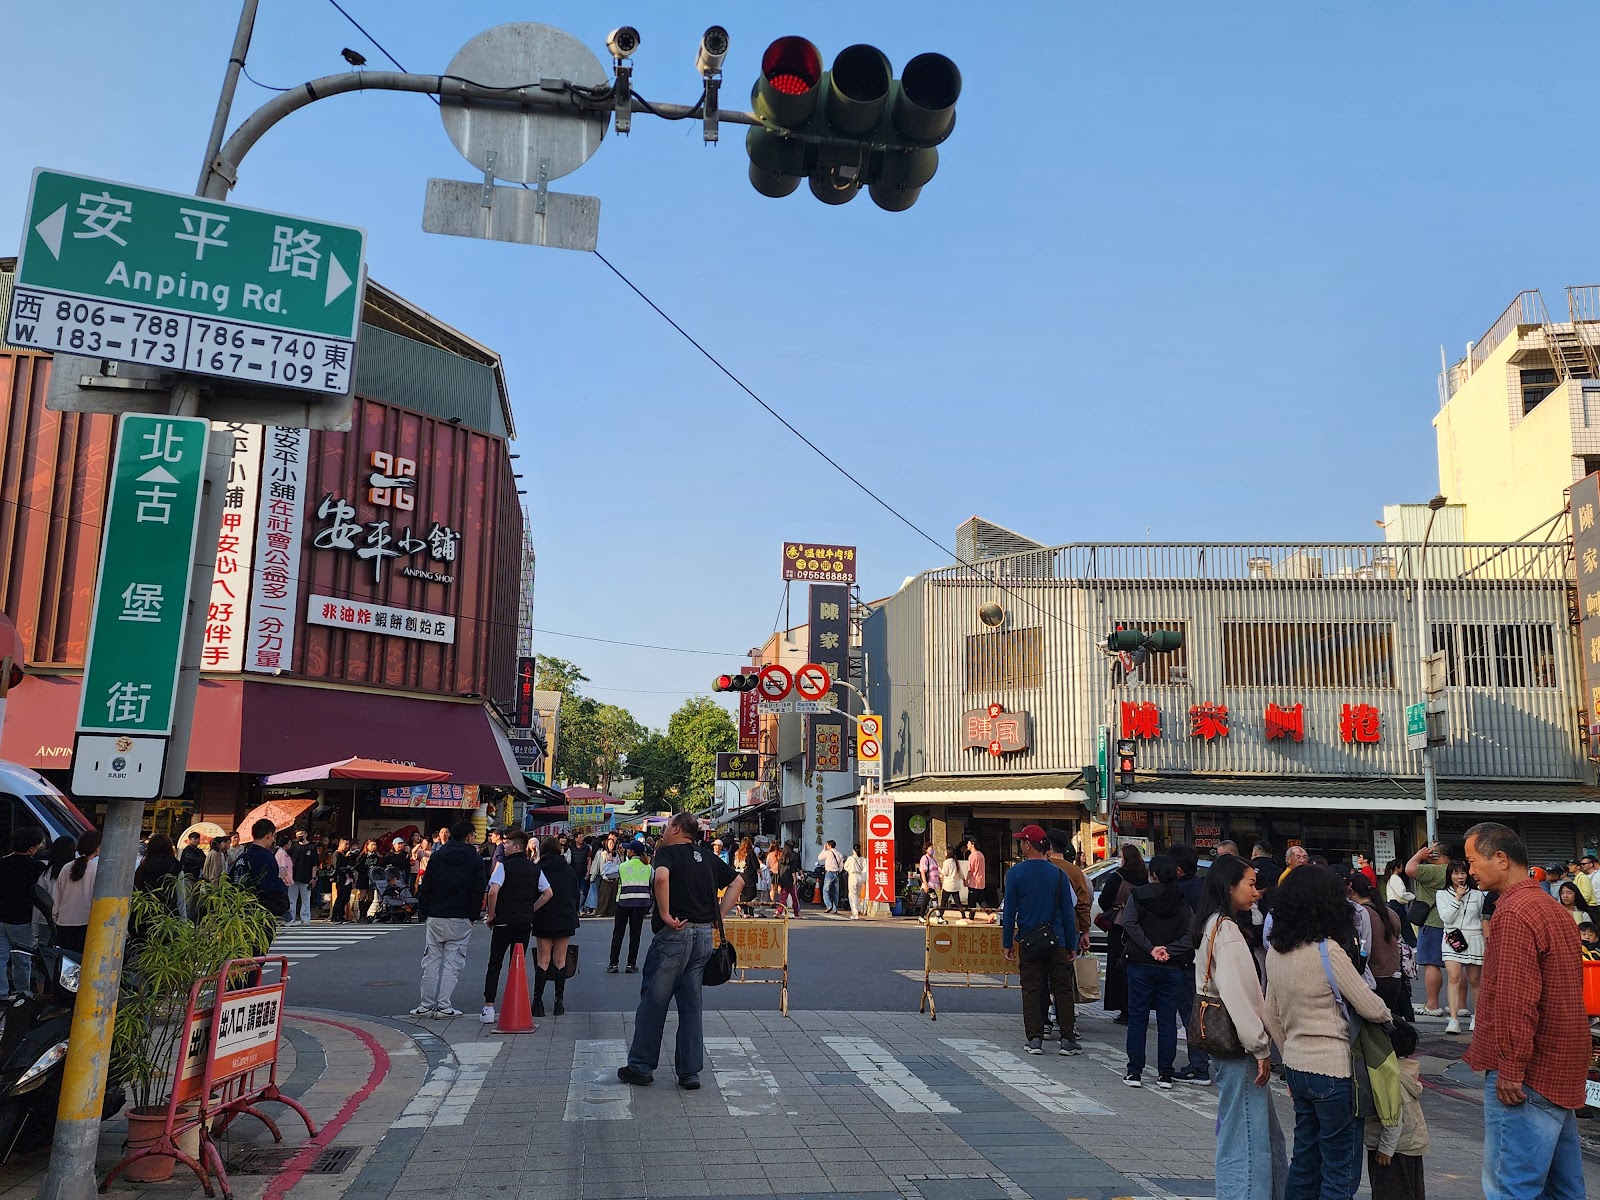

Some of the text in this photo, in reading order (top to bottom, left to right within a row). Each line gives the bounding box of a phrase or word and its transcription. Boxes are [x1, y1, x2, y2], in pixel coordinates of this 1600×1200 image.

[72, 191, 322, 280] 安平路
[105, 261, 288, 315] Anping Rd.
[15, 293, 44, 322] 西
[56, 301, 179, 338] 806-788
[15, 323, 38, 344] W.
[56, 326, 176, 363] 183-173
[199, 324, 316, 360] 786-740
[197, 349, 313, 384] 167-109
[322, 344, 348, 370] 東
[324, 371, 341, 390] E.
[139, 423, 184, 463] 北
[313, 492, 461, 583] 安平小舖
[403, 567, 455, 584] ANPING SHOP
[797, 570, 853, 582] 0955268882
[106, 486, 178, 723] 古堡街
[989, 706, 999, 717] 安
[991, 743, 1000, 753] 平
[874, 841, 888, 901] 禁止進入
[957, 933, 1017, 955] 禁止各種
